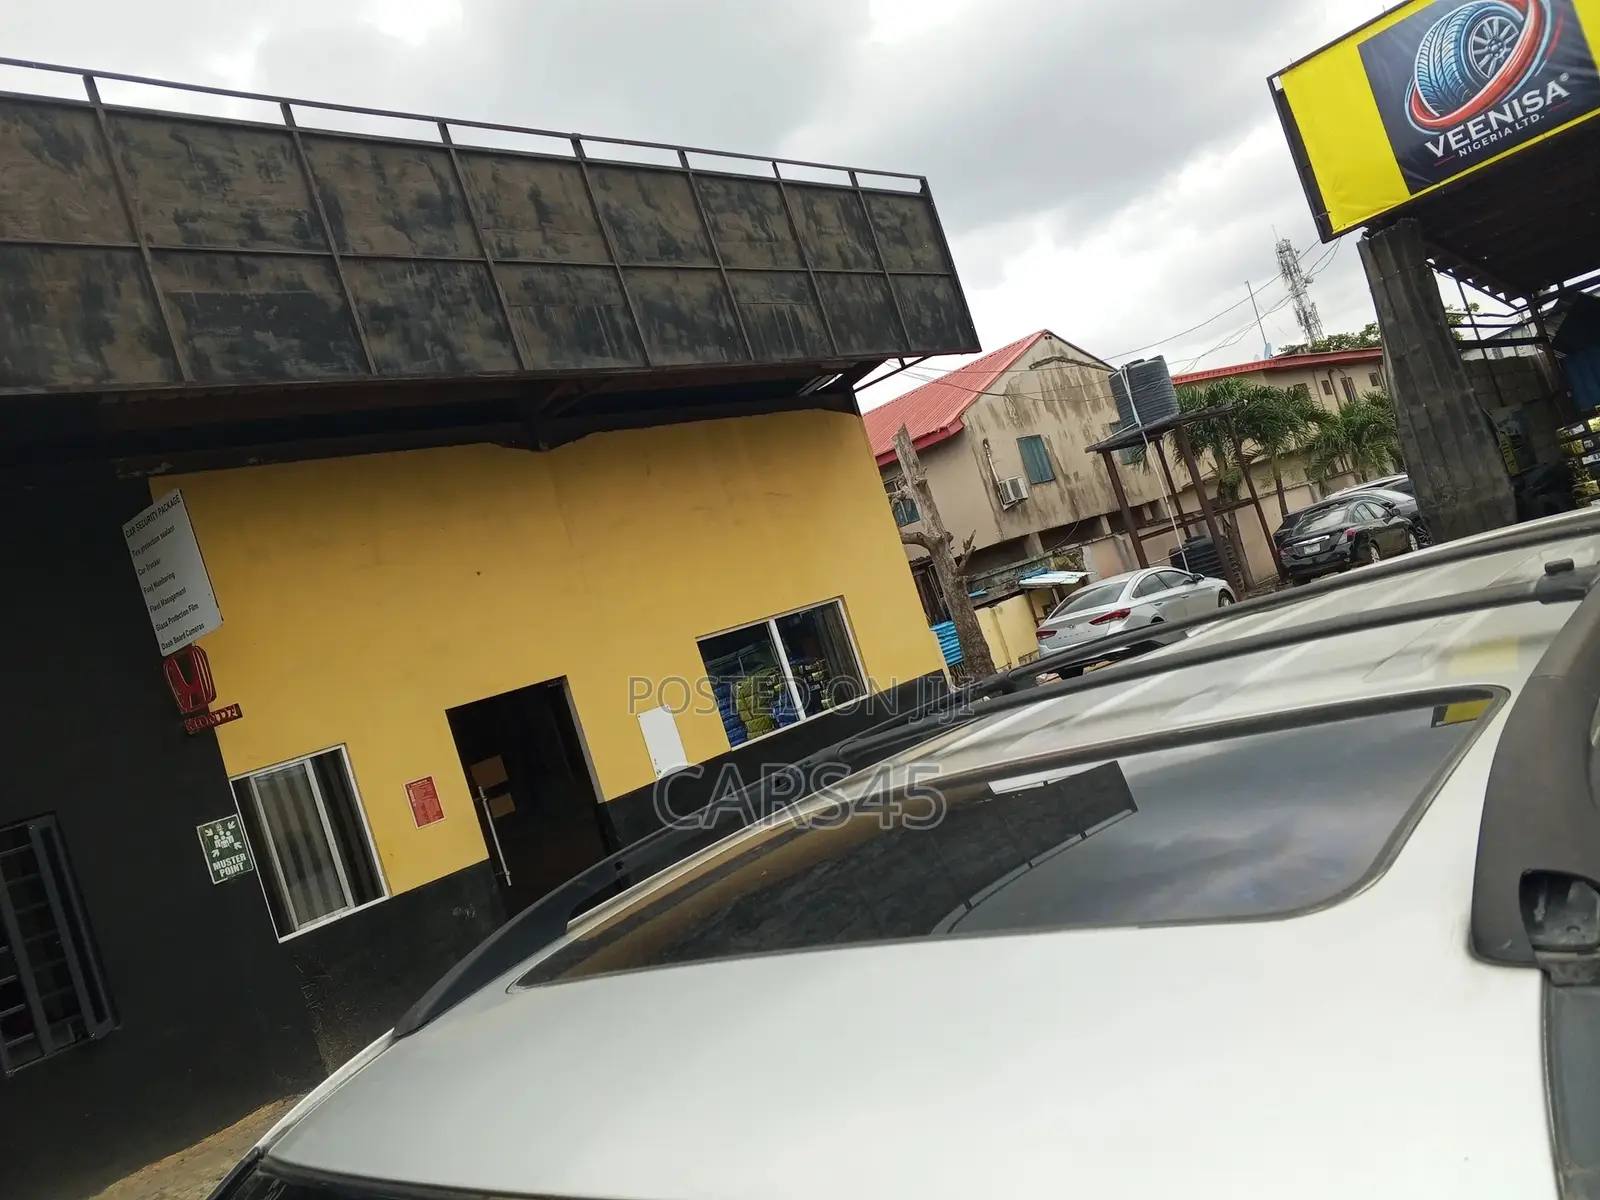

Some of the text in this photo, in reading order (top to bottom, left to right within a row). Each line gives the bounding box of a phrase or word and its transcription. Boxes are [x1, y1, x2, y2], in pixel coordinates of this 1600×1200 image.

[1458, 114, 1545, 157] NIGERIA LTD.
[125, 525, 137, 539] CAR
[157, 493, 181, 517] PACKAGE
[155, 603, 200, 632] Glass Protection Film
[160, 640, 174, 651] Dash
[185, 622, 205, 637] Cameras
[212, 853, 247, 871] MUSTER
[219, 862, 245, 878] POINT
